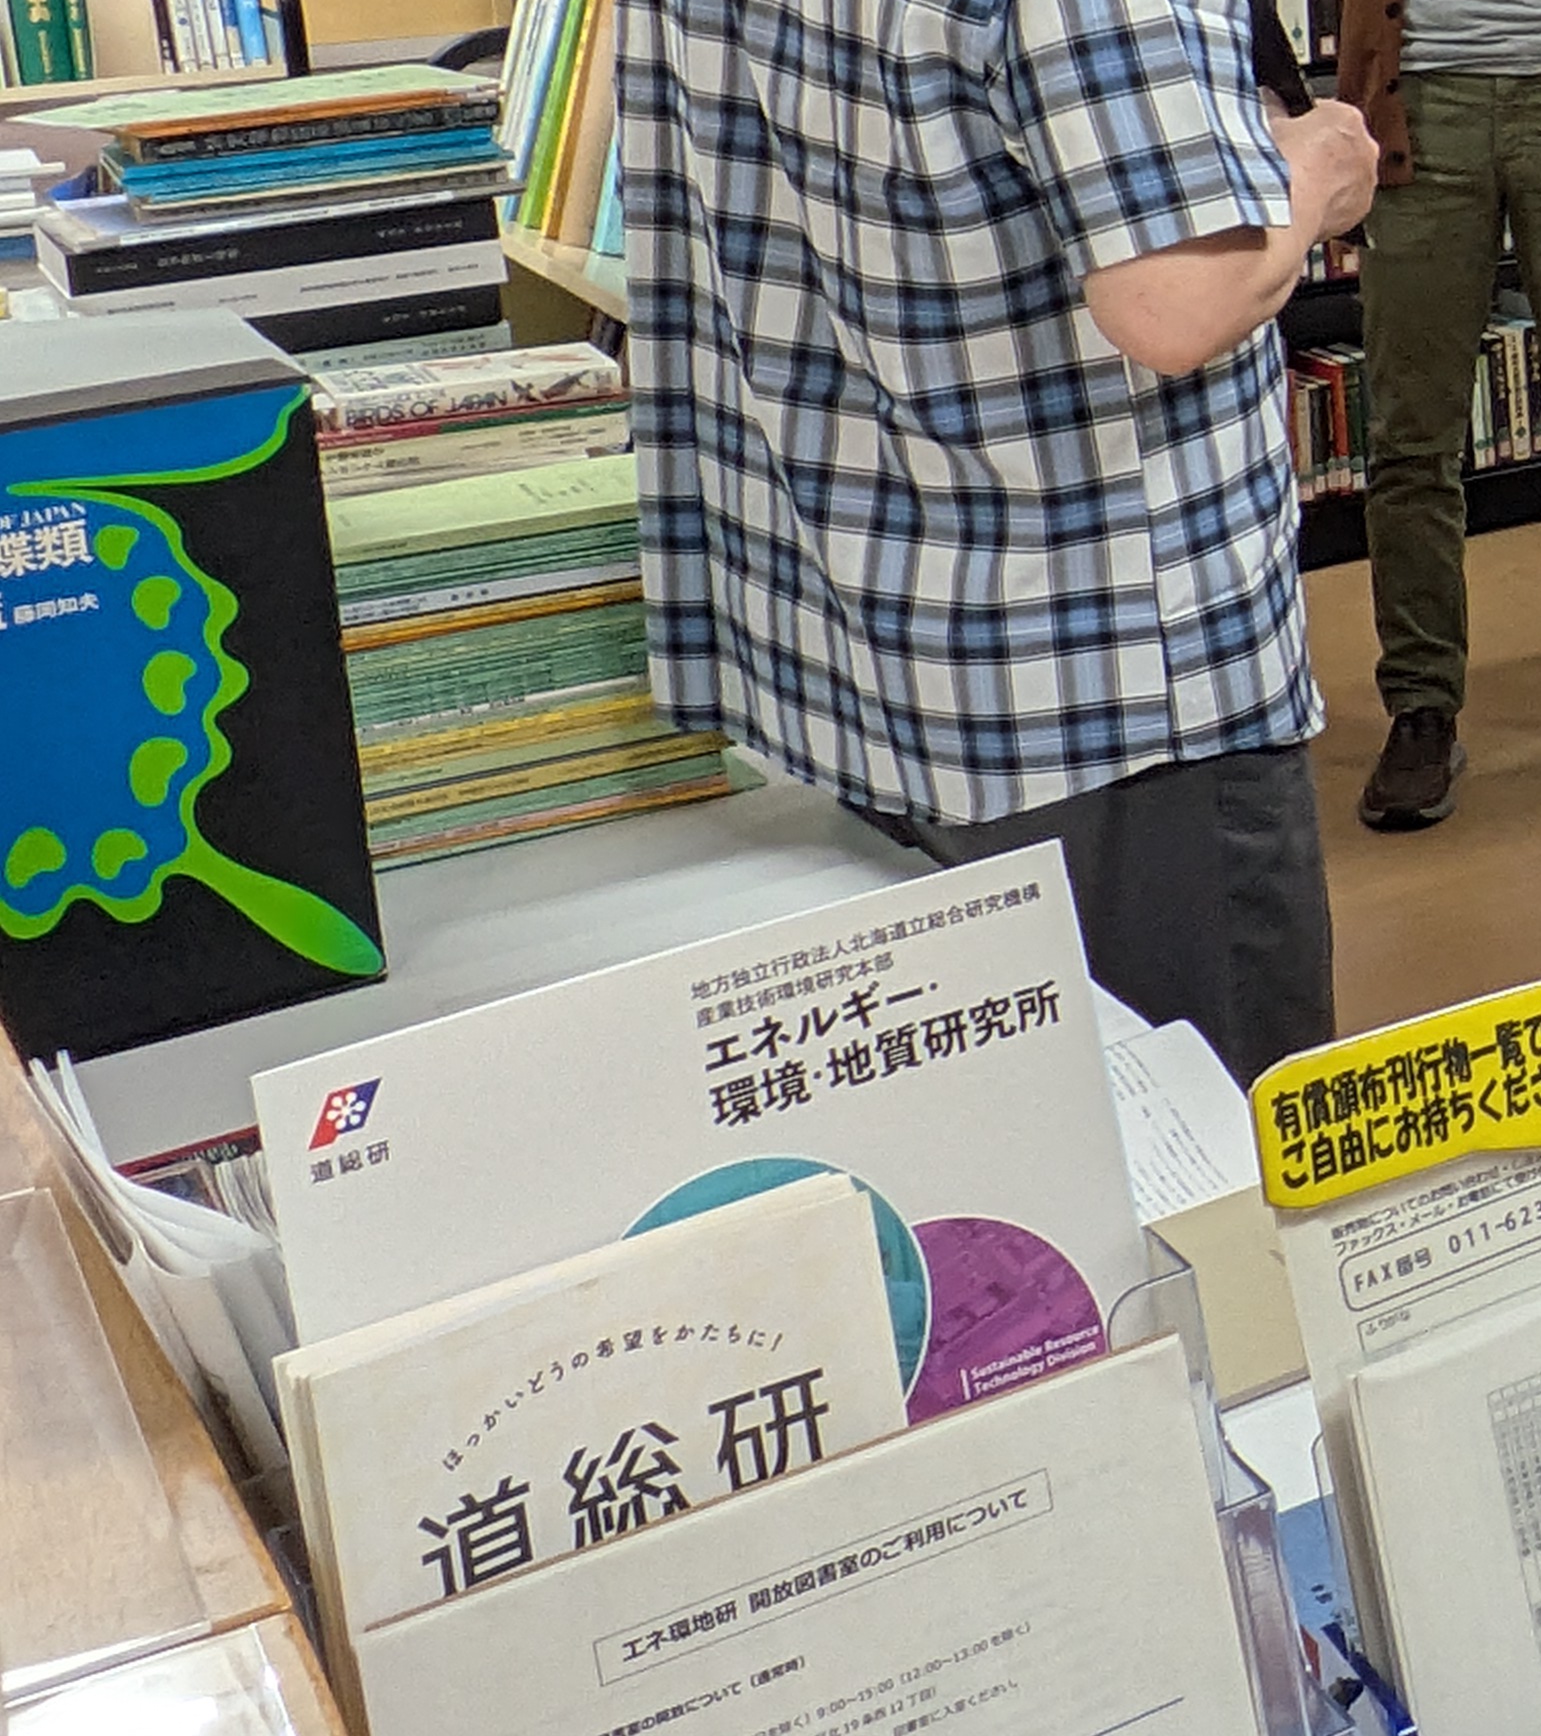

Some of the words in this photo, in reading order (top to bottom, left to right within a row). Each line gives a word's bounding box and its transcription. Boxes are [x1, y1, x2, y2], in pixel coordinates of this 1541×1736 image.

[346, 405, 404, 430] BIRDS
[410, 400, 438, 418] OF
[446, 390, 508, 413] JAPAN
[21, 502, 87, 528] JAPAN
[710, 980, 1061, 1127] 環境・地質研究所
[310, 1140, 391, 1183] 道総研
[1353, 1249, 1433, 1293] FAX番号
[970, 1345, 1043, 1380] Sustainable
[1044, 1324, 1100, 1353] Resource
[974, 1360, 1046, 1395] Technology
[1046, 1340, 1097, 1367] Division
[748, 1489, 1029, 1613] 開放図書室のご利用について
